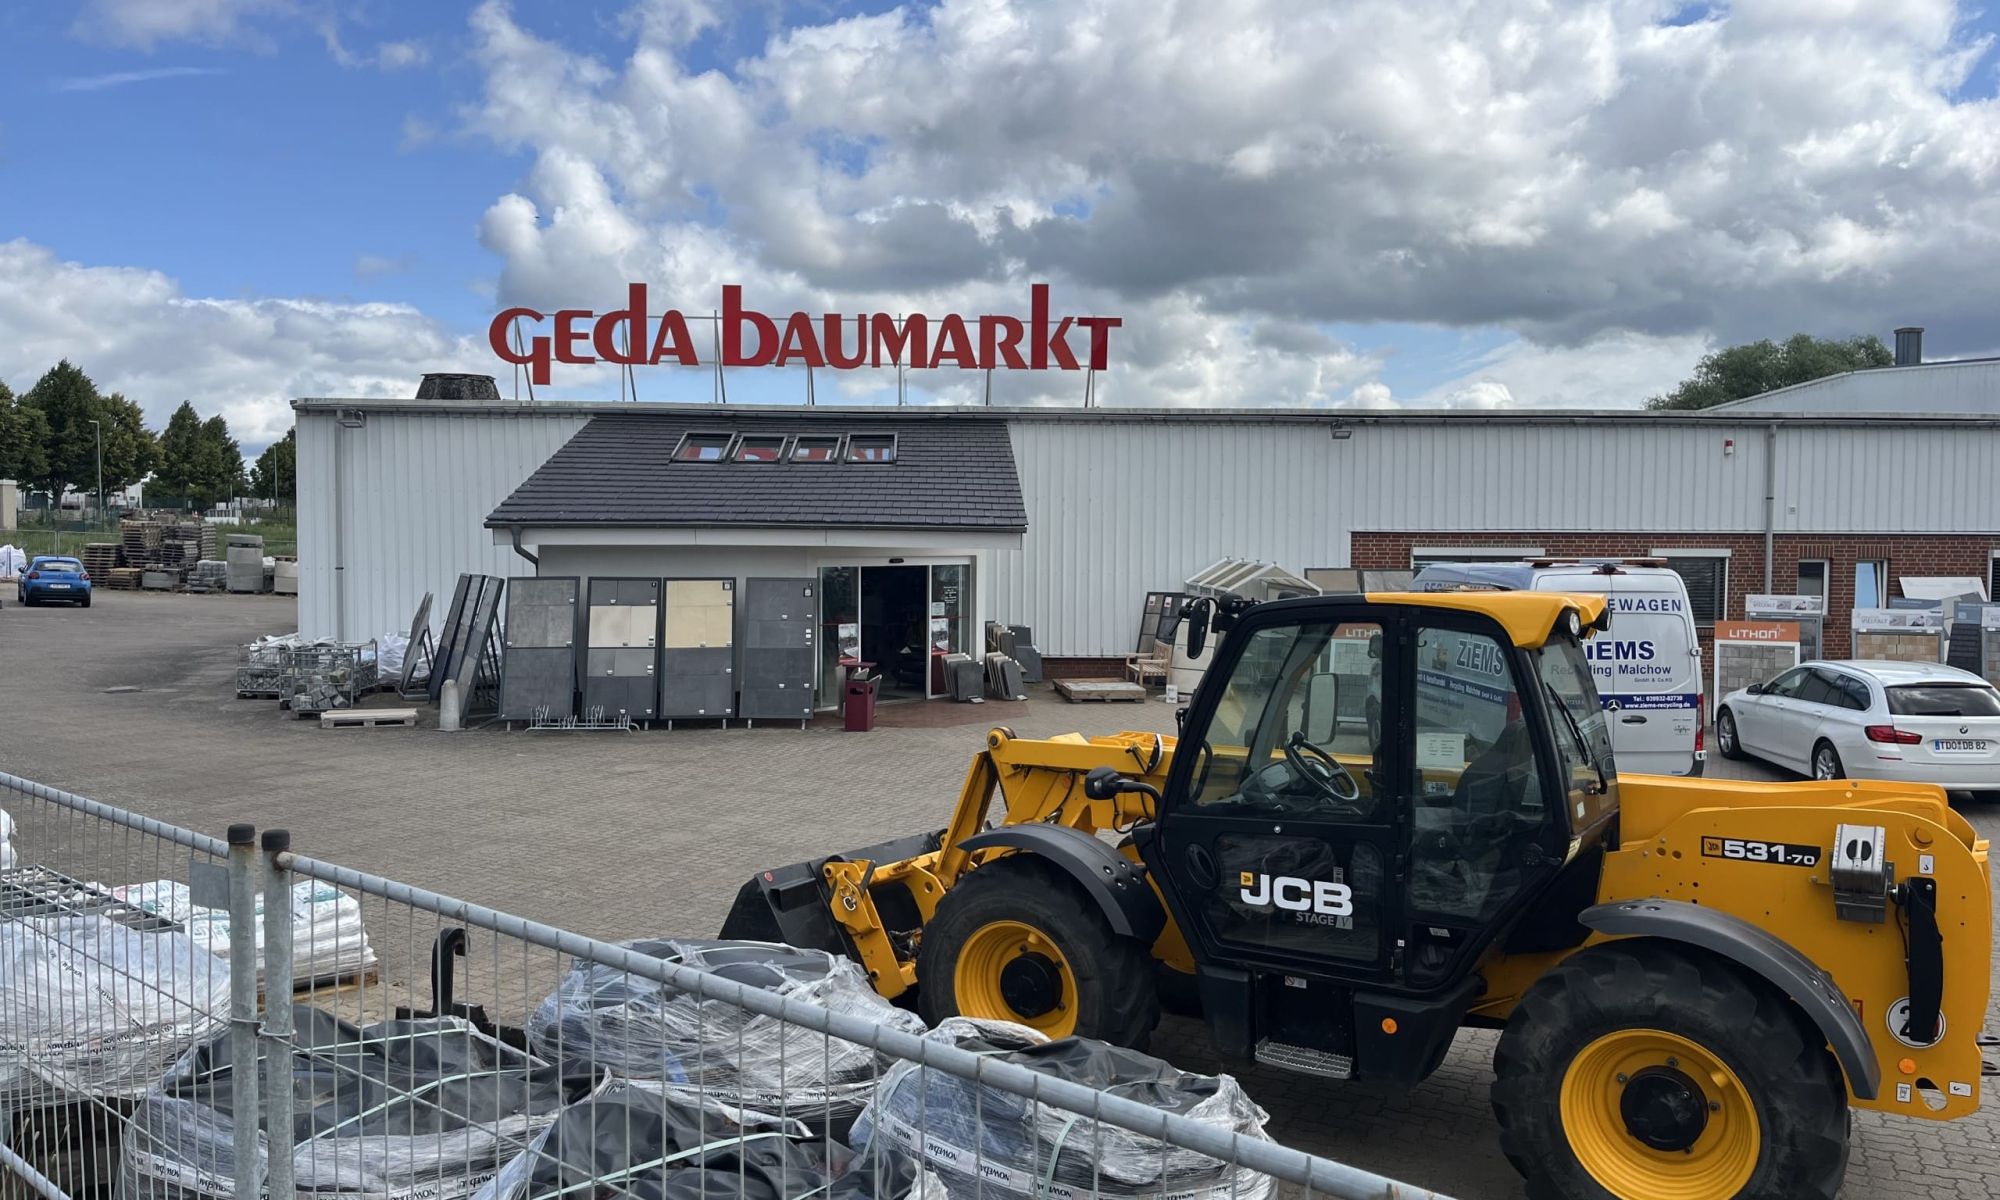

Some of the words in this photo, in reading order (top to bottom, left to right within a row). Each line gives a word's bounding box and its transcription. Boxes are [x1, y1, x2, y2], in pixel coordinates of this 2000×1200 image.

[1607, 598, 1682, 611] EWAGEN
[1619, 664, 1672, 675] Malchow
[1240, 872, 1353, 916] JCB
[1296, 912, 1335, 926] STAGE
